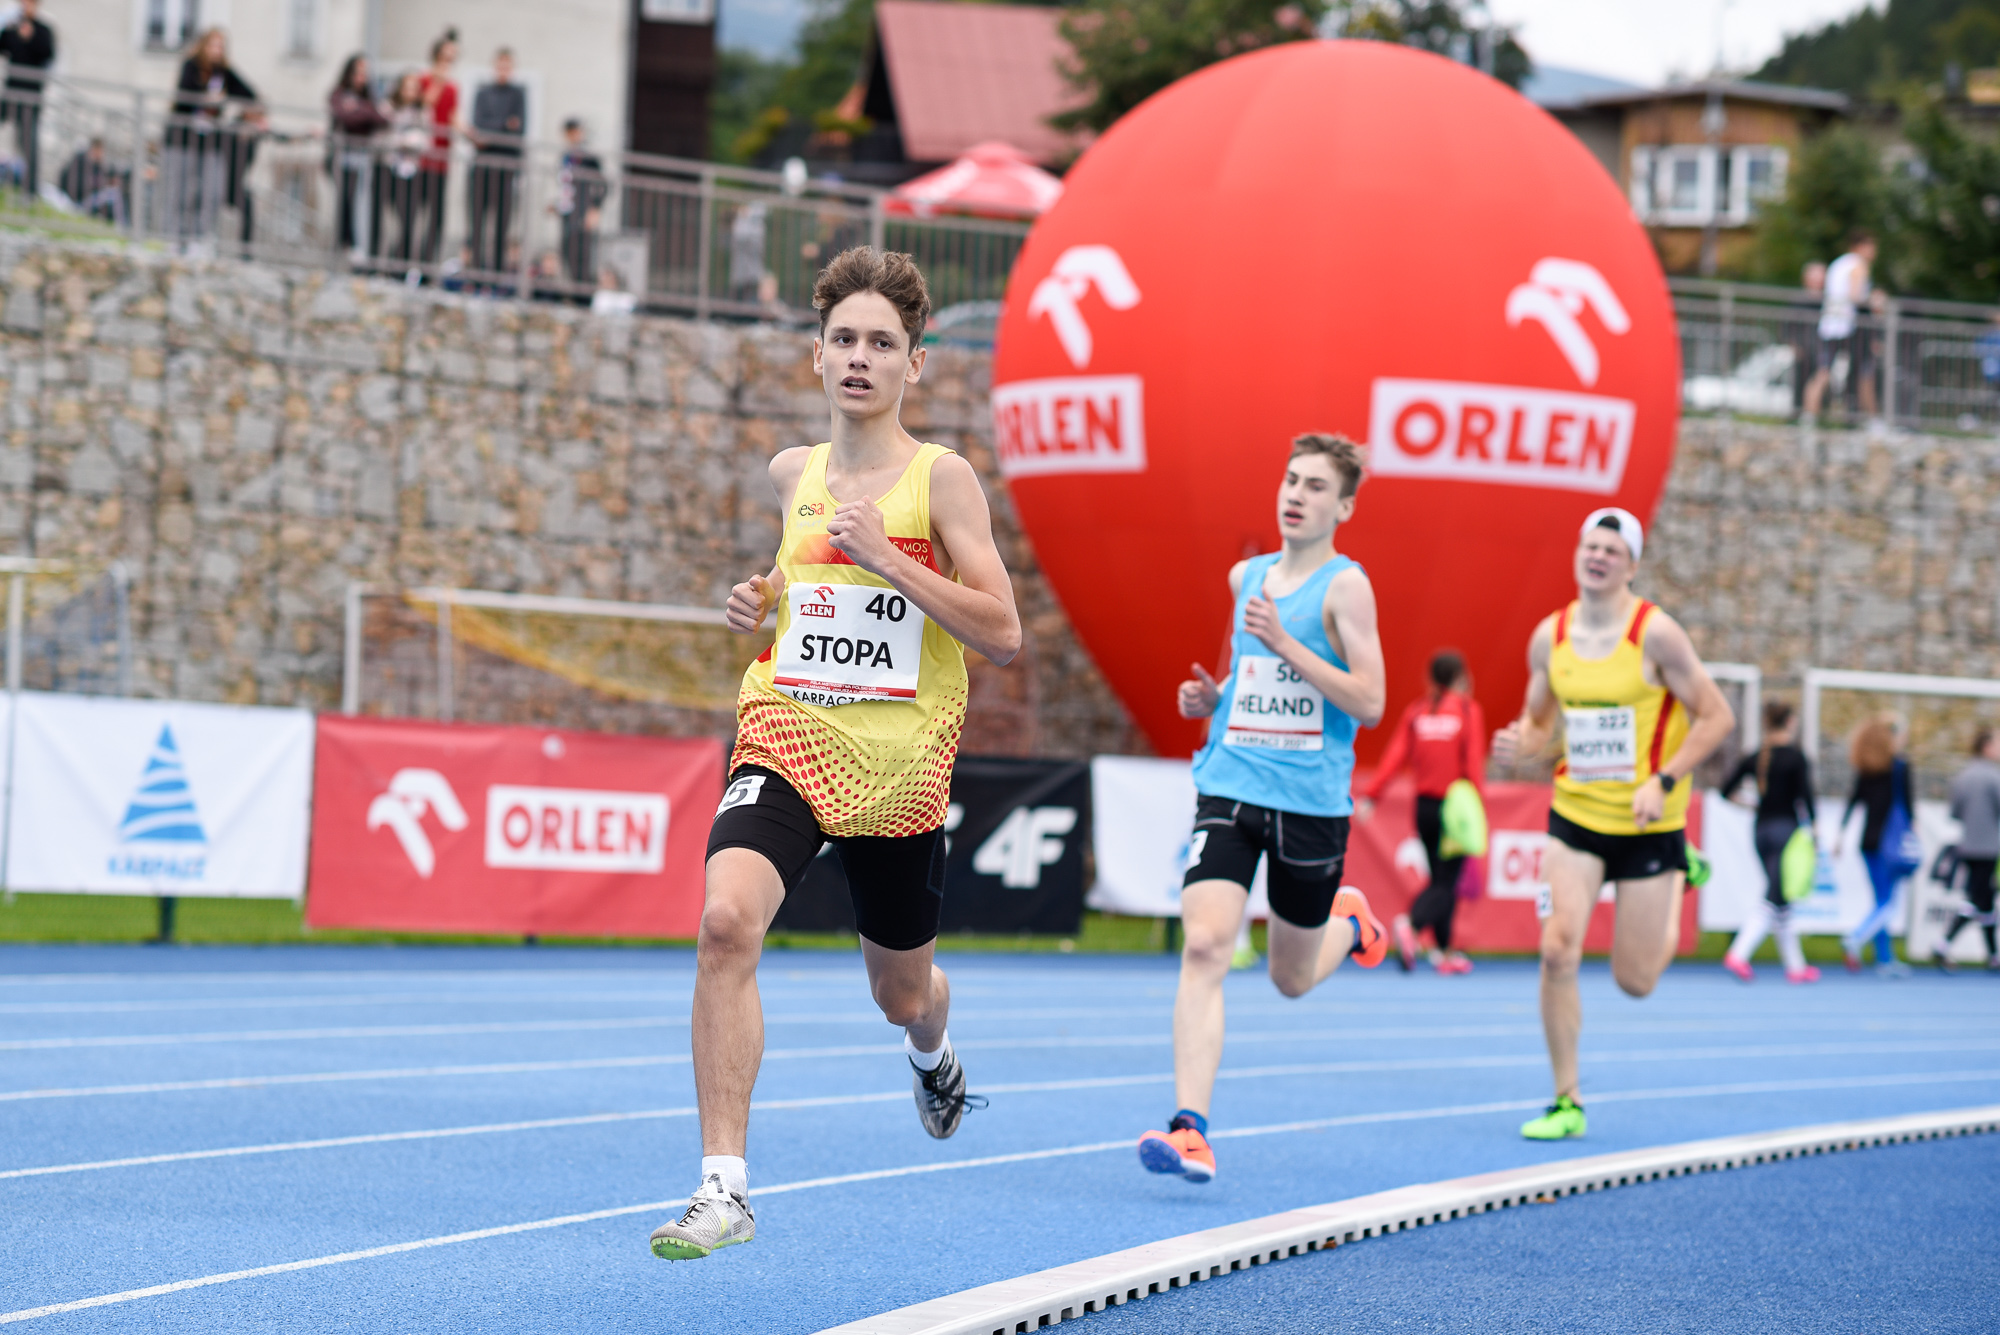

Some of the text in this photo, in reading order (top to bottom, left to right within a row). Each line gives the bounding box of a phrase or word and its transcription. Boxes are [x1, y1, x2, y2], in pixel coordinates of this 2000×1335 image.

[1393, 401, 1617, 472] ORLEN
[902, 542, 928, 553] MOS
[865, 593, 907, 622] 40
[800, 634, 893, 669] STOPA
[1236, 695, 1314, 716] HELAND
[1571, 740, 1628, 758] MOTYK
[723, 779, 752, 807] 5
[503, 805, 652, 854] ORLEN
[972, 806, 1078, 888] 4F
